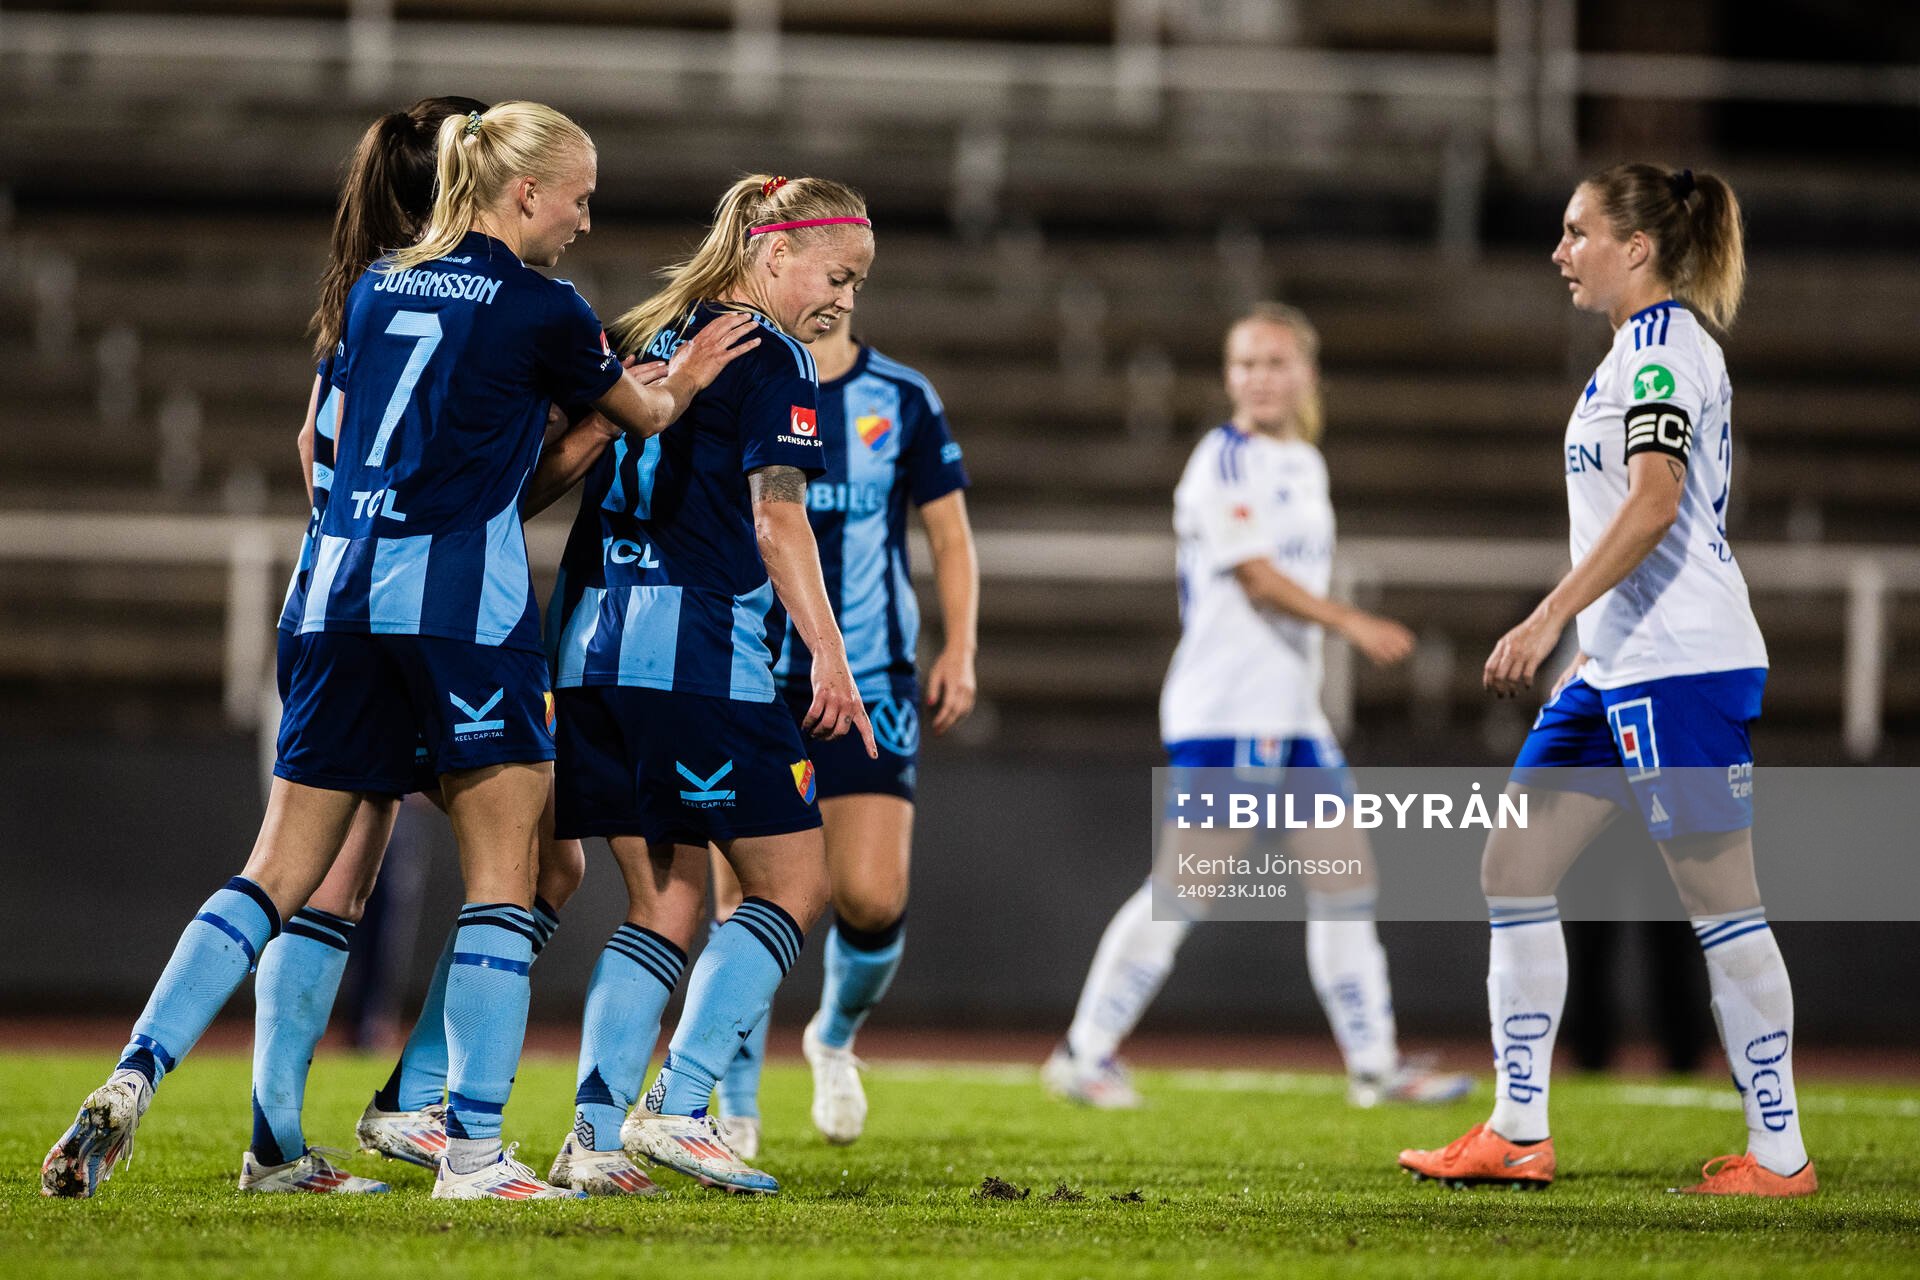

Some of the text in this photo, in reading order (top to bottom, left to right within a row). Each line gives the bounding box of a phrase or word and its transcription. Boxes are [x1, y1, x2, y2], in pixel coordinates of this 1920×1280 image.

[374, 265, 503, 305] JOHANSSON
[365, 310, 443, 467] 7
[777, 434, 812, 447] SVENSKA
[1656, 412, 1684, 449] C
[350, 488, 407, 523] TCL
[805, 481, 881, 513] BILL
[602, 535, 660, 569] TCL
[454, 731, 504, 743] KEEL CAPITAL
[1503, 1012, 1552, 1104] Ocab
[1745, 1030, 1793, 1132] Ocab
